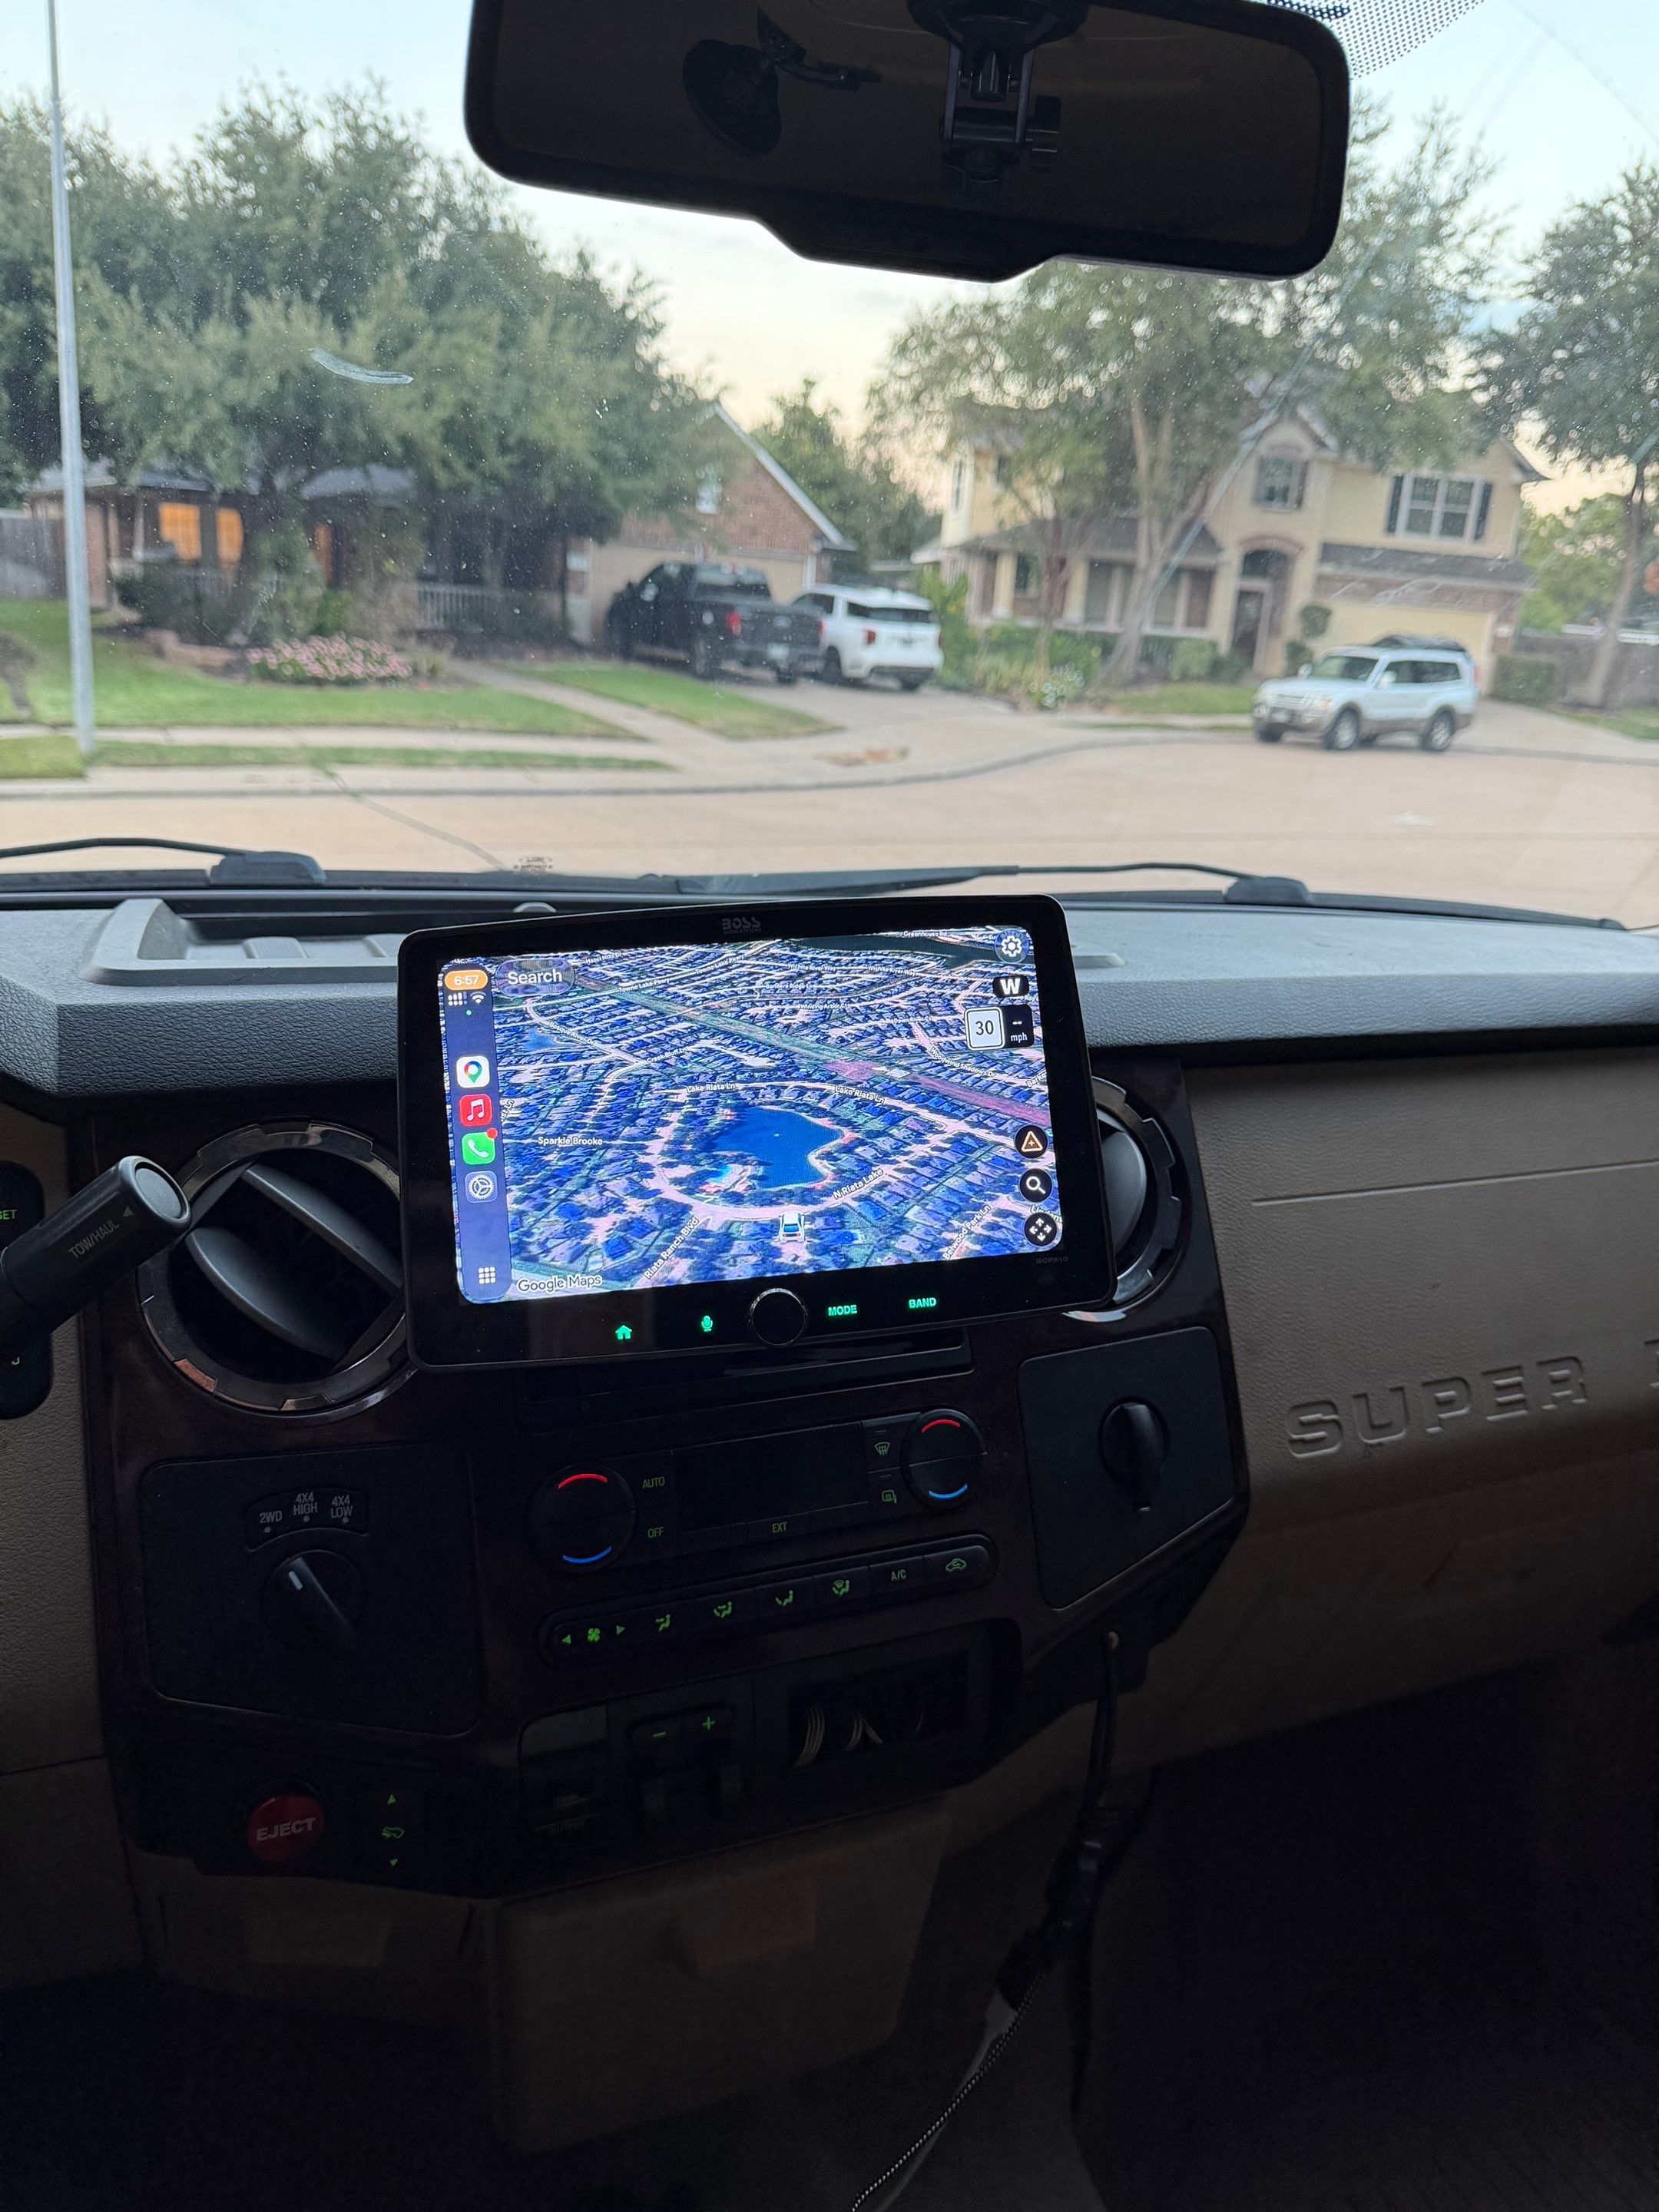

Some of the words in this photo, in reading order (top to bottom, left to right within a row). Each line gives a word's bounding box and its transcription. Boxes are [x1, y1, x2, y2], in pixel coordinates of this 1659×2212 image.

[453, 975, 479, 985] 6:57
[507, 969, 563, 985] Search
[999, 978, 1022, 995] W
[975, 1020, 995, 1036] 30
[1010, 1032, 1028, 1044] mph
[929, 1046, 961, 1068] Woodwind
[959, 1063, 988, 1076] Shadows
[686, 1085, 704, 1094] Lake
[835, 1084, 853, 1096] Lake
[854, 1088, 874, 1101] Riata
[874, 1094, 886, 1104] Ln
[538, 1137, 571, 1147] Sparkle
[572, 1137, 604, 1146] Brooke
[832, 1189, 843, 1200] N
[840, 1177, 865, 1195] Riata
[863, 1167, 885, 1186] Lake
[68, 1220, 120, 1258] TOW/HAUL
[942, 1224, 969, 1260] Belwood
[965, 1211, 984, 1231] Park
[979, 1204, 992, 1217] Ln
[643, 1257, 664, 1280] Riata
[660, 1234, 685, 1260] Ranch
[681, 1216, 700, 1238] Blvd
[517, 1276, 565, 1293] Google
[568, 1274, 602, 1290] Maps
[828, 1304, 858, 1317] MODE
[909, 1297, 937, 1310] BAND
[1286, 1355, 1588, 1459] SUPER
[642, 1476, 666, 1489] AUTO
[293, 1502, 319, 1516] HIGH
[330, 1505, 353, 1518] LOW
[259, 1510, 283, 1524] 2WD
[647, 1526, 664, 1538] OFF
[772, 1521, 788, 1533] EXT
[891, 1568, 907, 1581] A/C
[255, 1816, 317, 1843] EJECT
